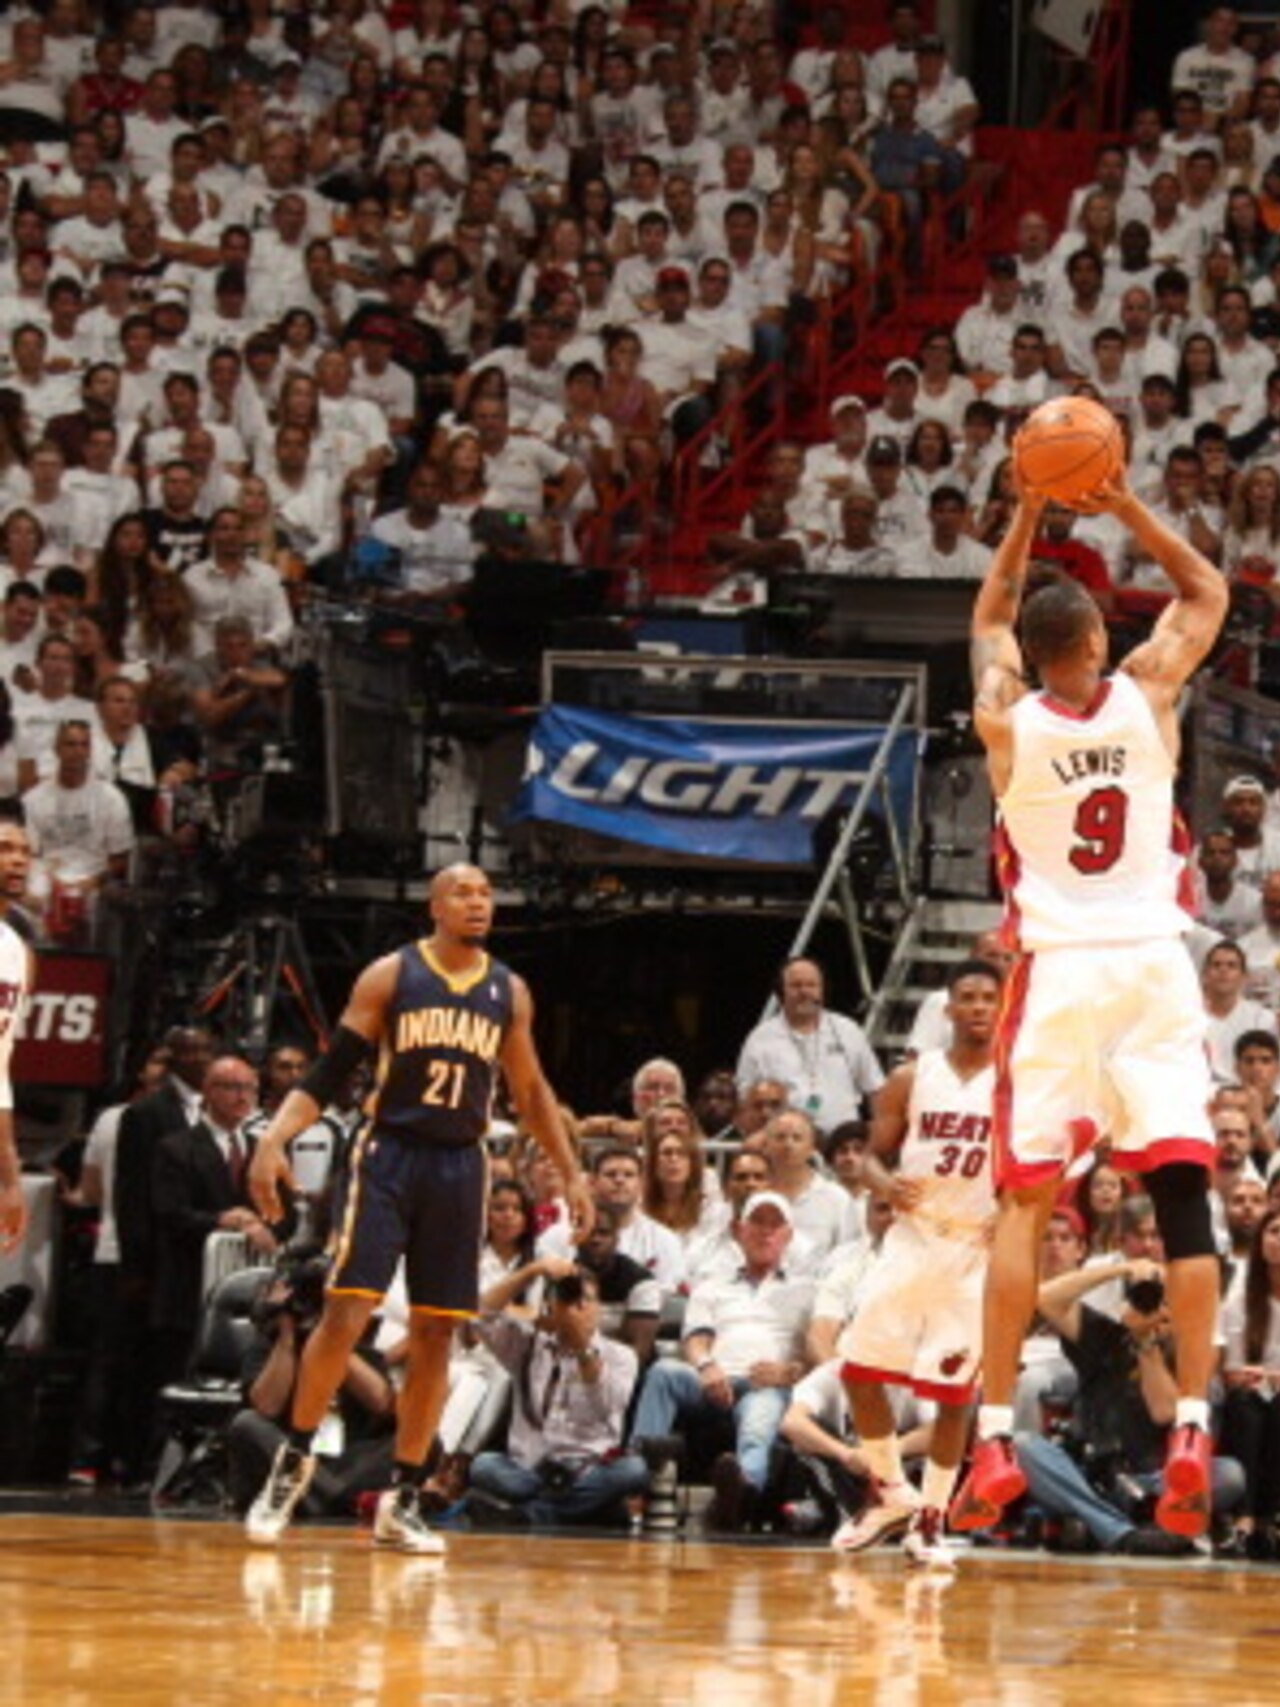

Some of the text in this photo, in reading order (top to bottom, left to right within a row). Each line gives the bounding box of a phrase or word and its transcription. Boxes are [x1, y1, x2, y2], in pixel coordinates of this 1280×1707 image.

[550, 741, 874, 820] LIGHT
[1051, 746, 1127, 786] LEWIS
[1067, 784, 1130, 876] 9
[421, 1060, 465, 1109] 21
[935, 1145, 987, 1180] 30
